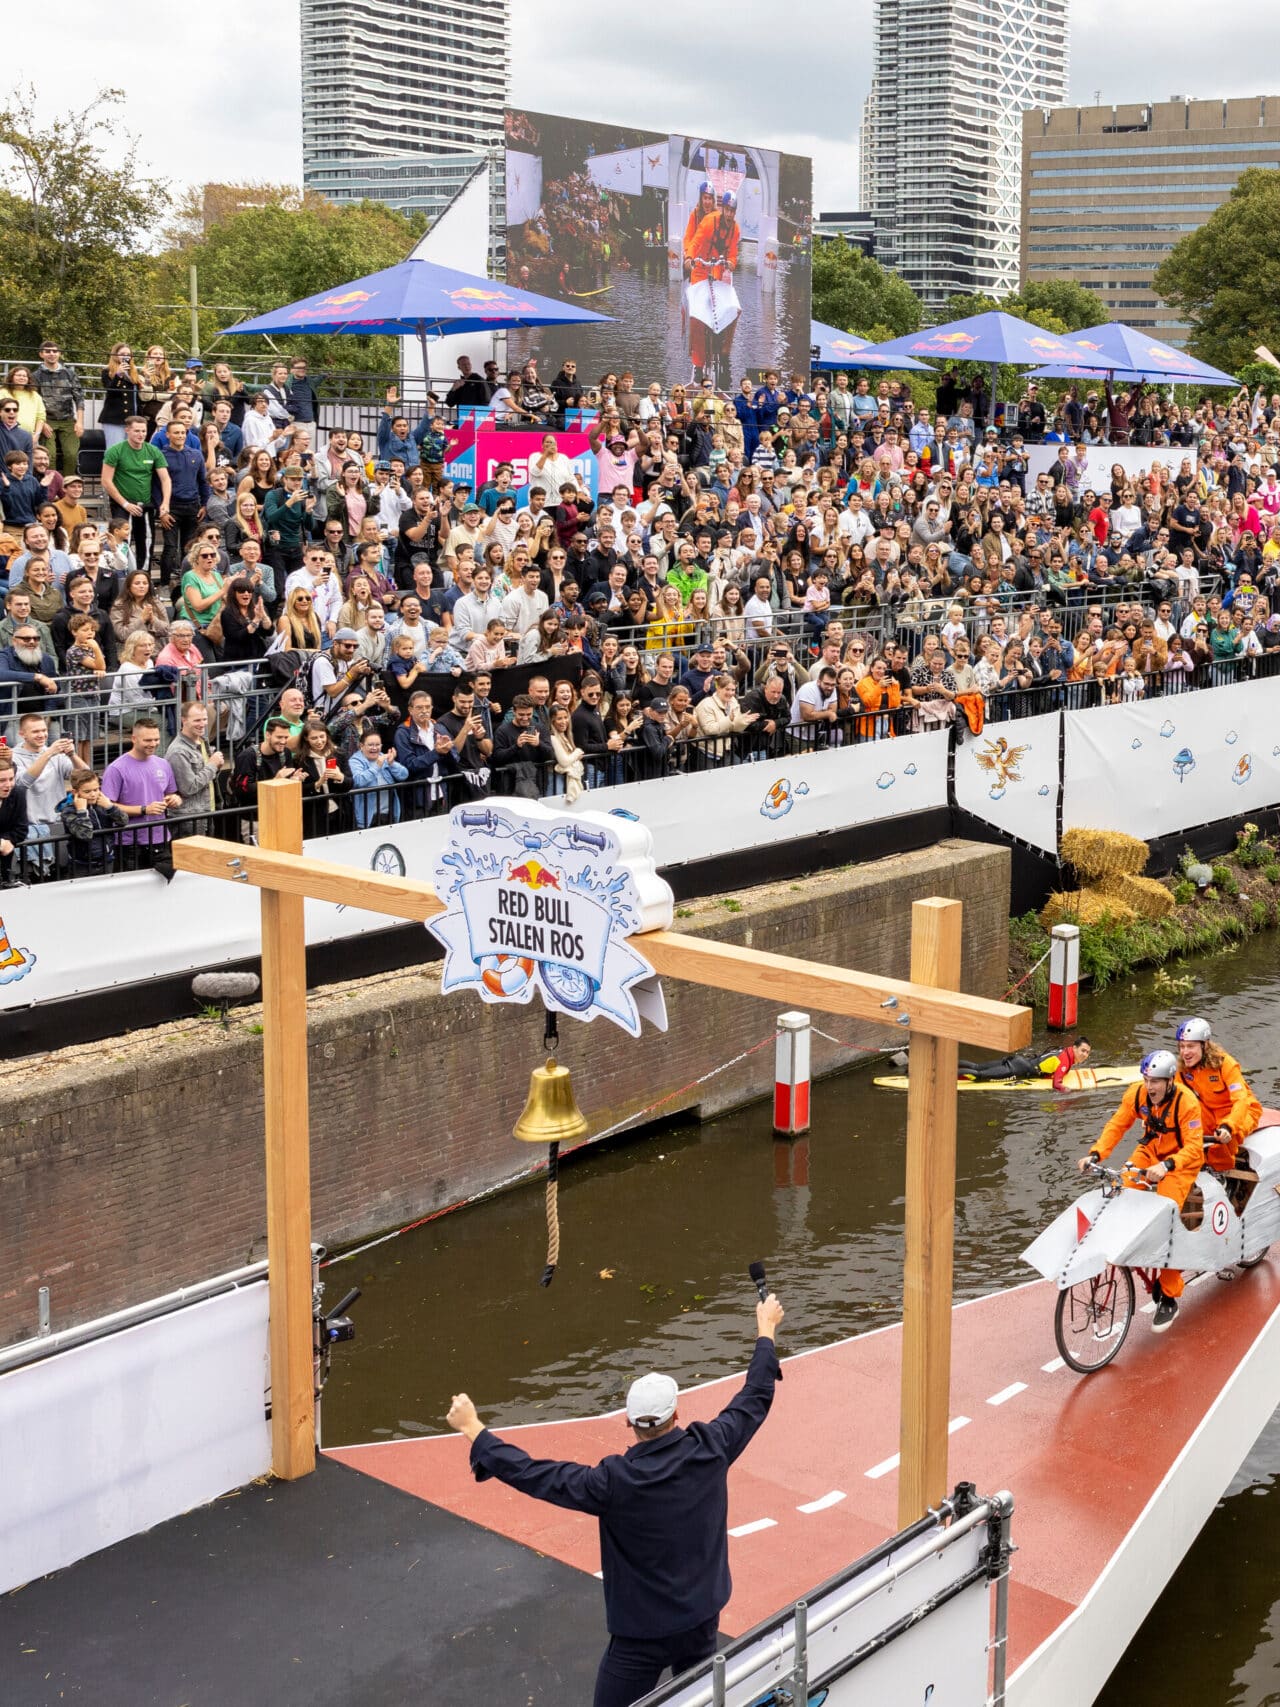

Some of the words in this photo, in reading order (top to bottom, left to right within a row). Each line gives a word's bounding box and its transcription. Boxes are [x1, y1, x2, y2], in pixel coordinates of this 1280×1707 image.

[443, 461, 473, 480] LAM!
[498, 888, 529, 918] RED
[535, 895, 573, 928] BULL
[488, 917, 545, 953] STALEN
[551, 929, 584, 961] ROS
[1218, 1209, 1224, 1227] 2
